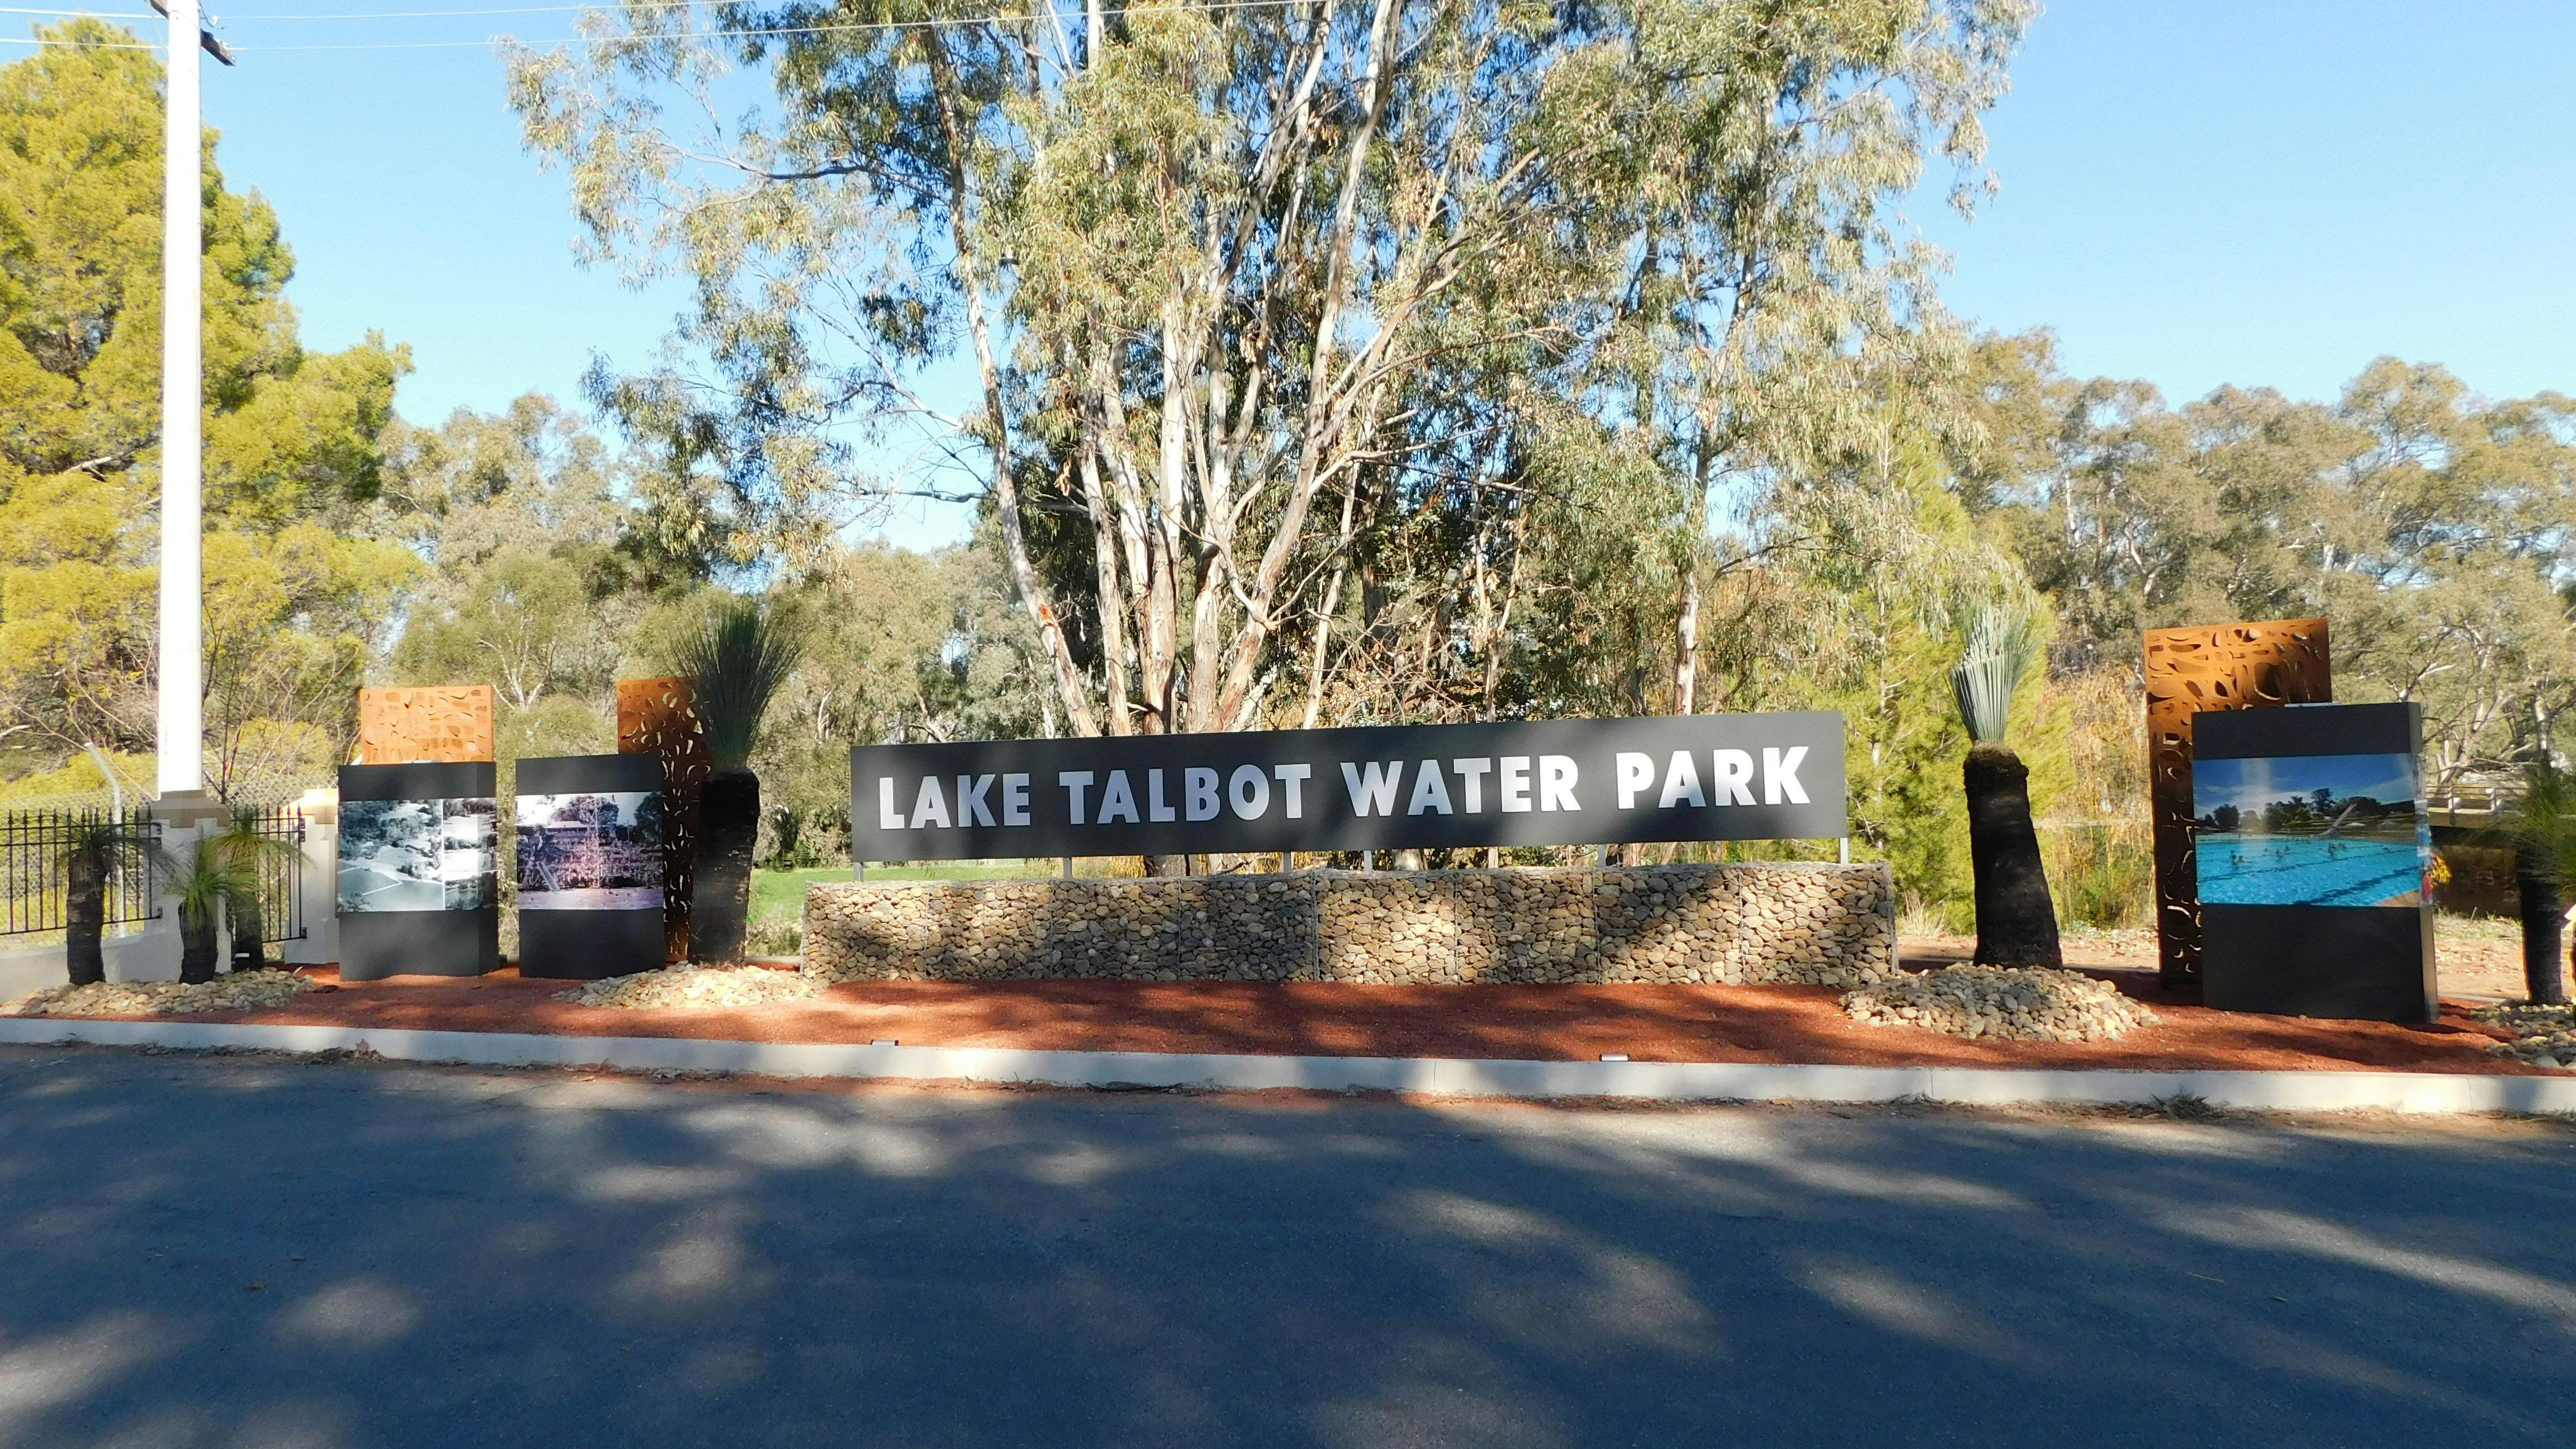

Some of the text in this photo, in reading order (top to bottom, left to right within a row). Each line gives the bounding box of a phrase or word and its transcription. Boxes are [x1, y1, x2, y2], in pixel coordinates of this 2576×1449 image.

[879, 746, 1810, 829] LAKE TALBOT WATER PARK
